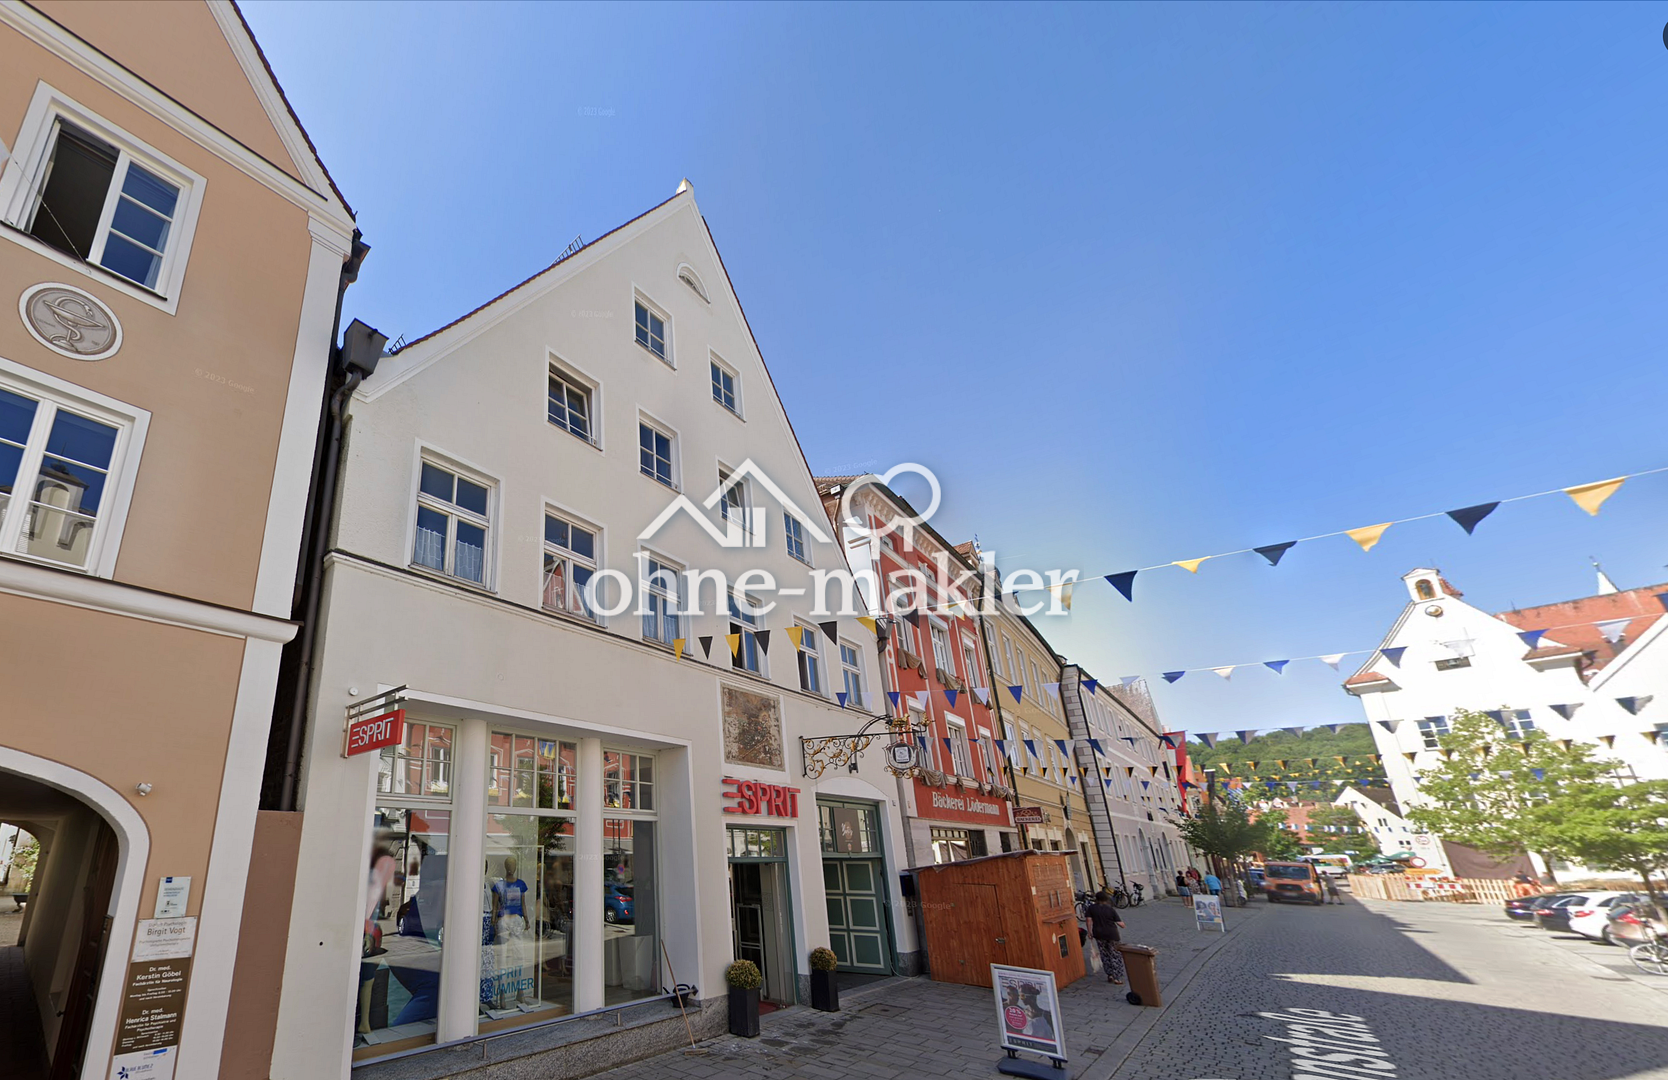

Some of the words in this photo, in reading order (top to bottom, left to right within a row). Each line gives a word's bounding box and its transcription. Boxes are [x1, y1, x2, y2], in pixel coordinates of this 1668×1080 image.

[351, 717, 394, 748] ESPRIT
[721, 778, 801, 818] ESPRIT
[931, 791, 965, 811] Bäckerei
[147, 927, 167, 937] Birgit
[169, 926, 186, 936] Vogt
[136, 973, 161, 981] Kerstin
[162, 970, 182, 978] Göbel
